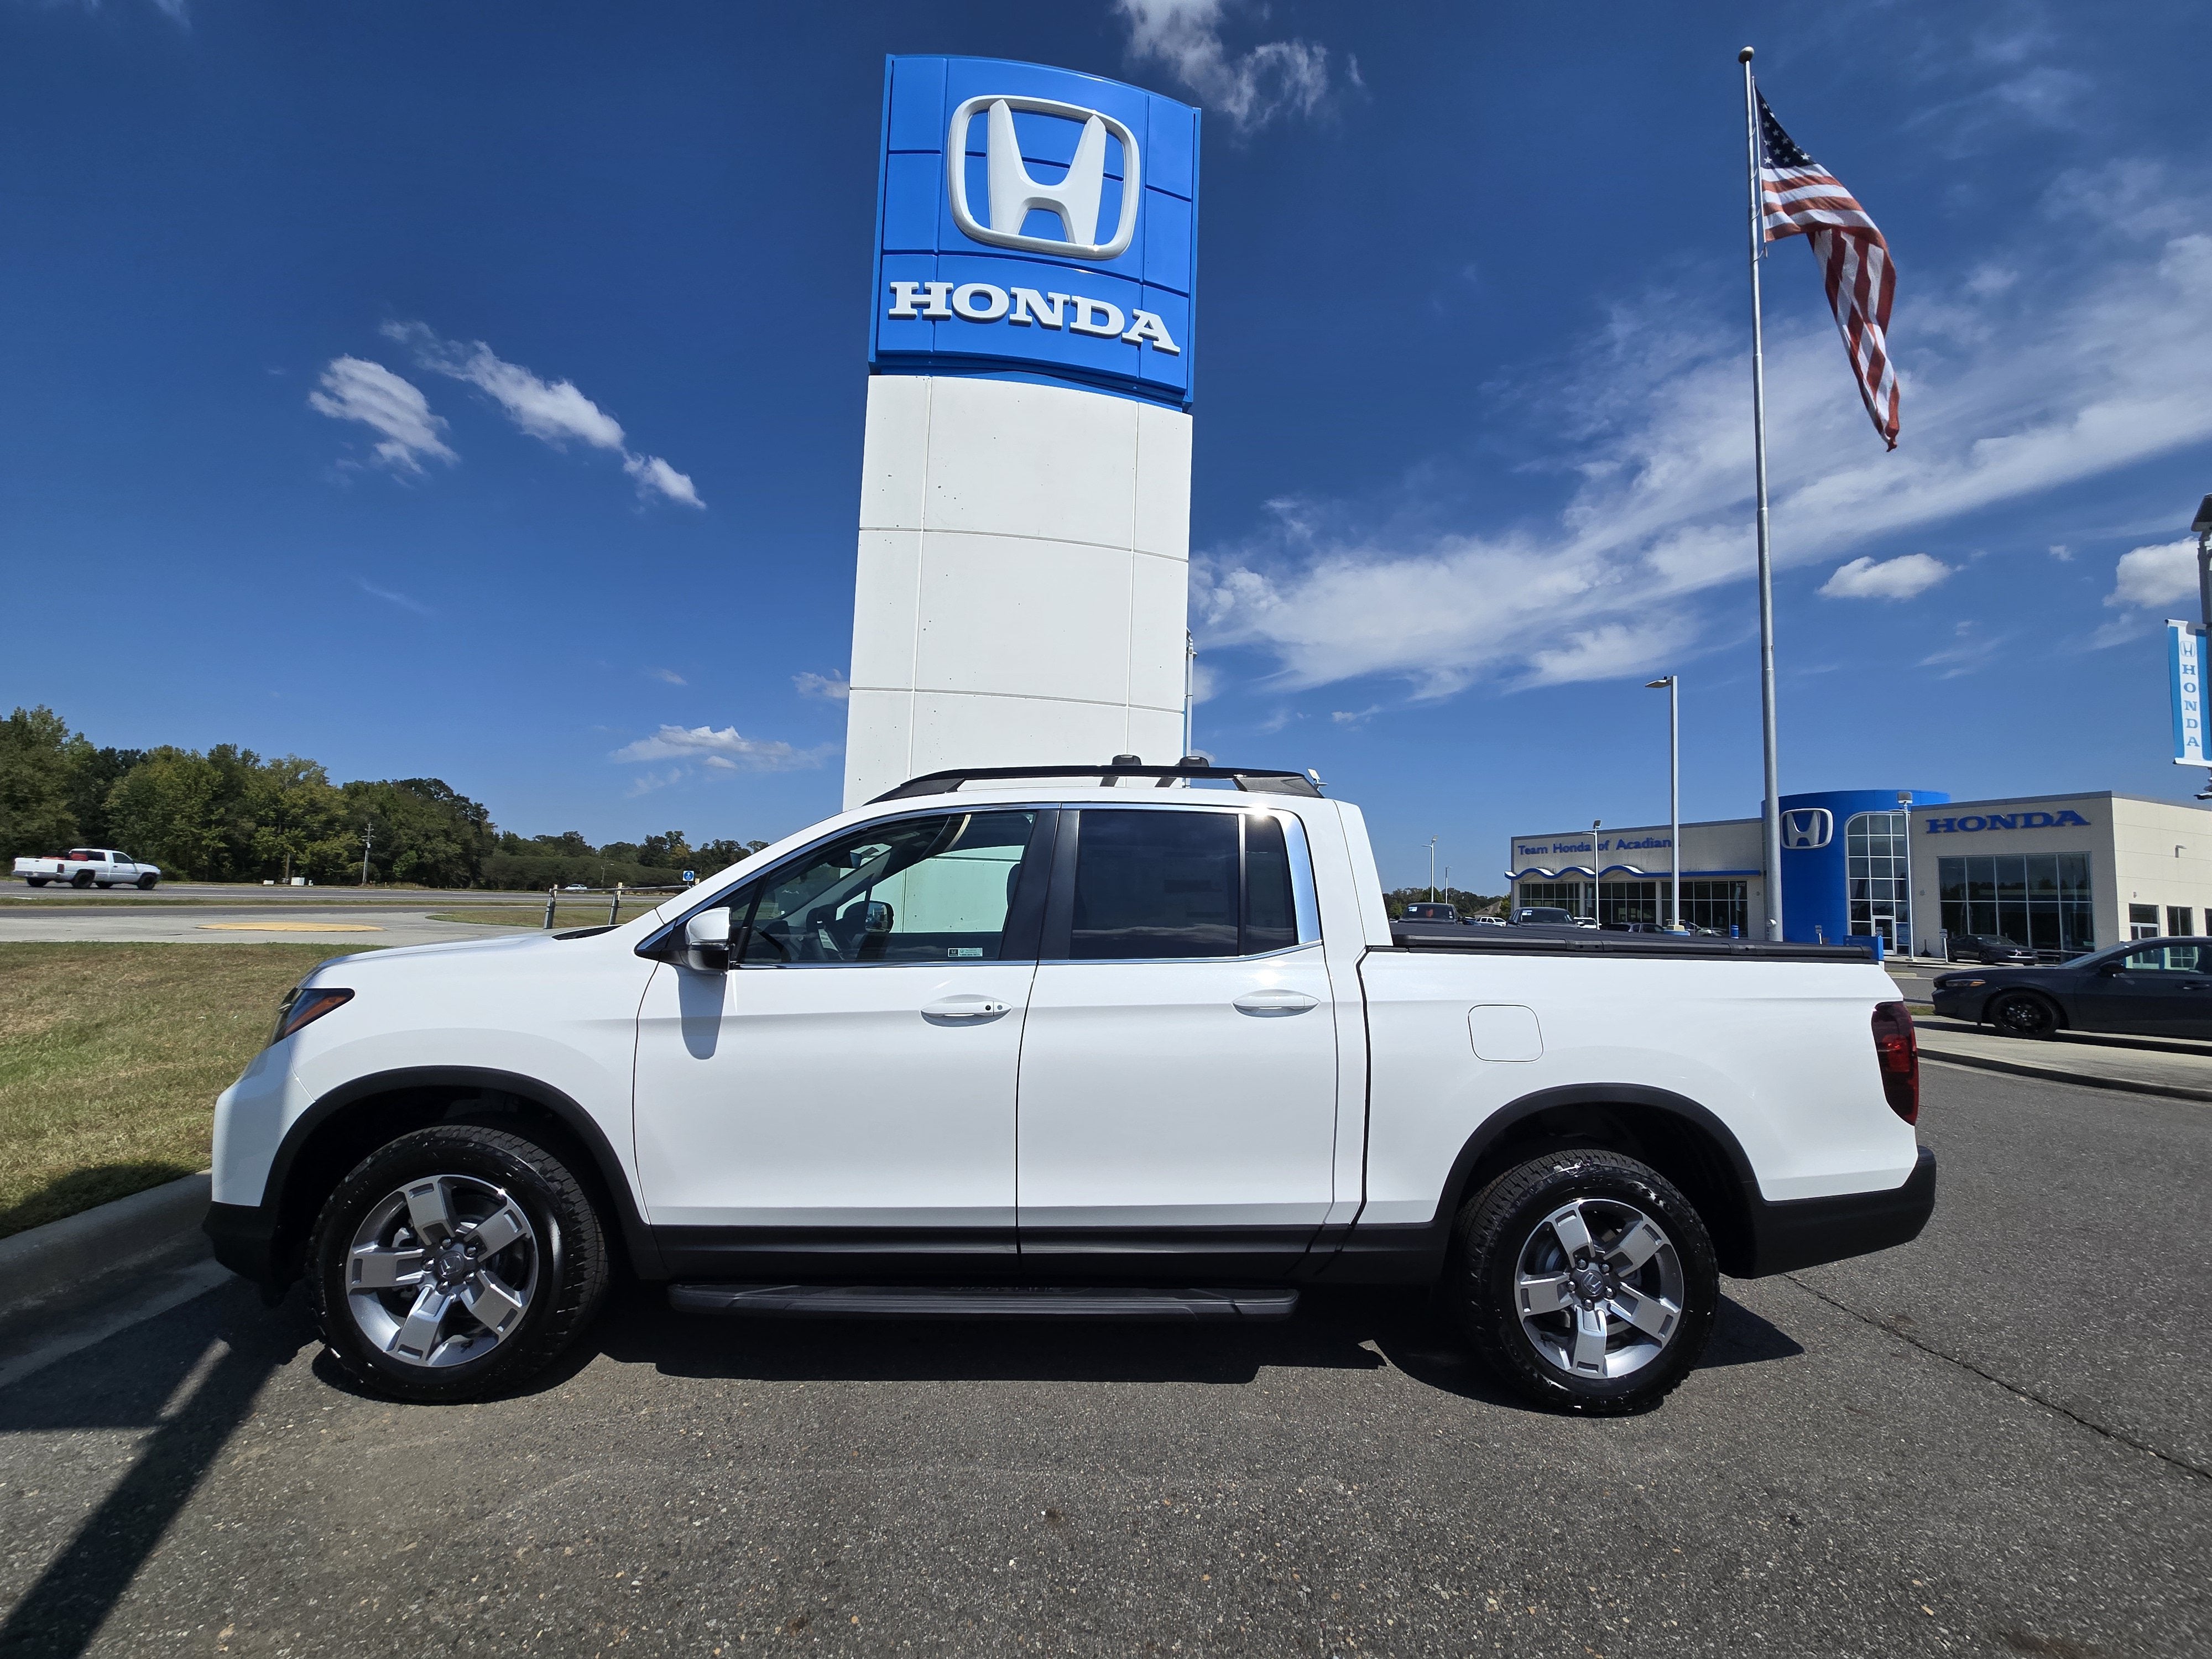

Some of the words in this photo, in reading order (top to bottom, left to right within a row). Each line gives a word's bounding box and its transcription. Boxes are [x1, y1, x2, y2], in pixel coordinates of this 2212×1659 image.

[888, 281, 1181, 355] HONDA
[2182, 664, 2200, 747] HONDA
[1517, 844, 1548, 855] Team
[1553, 841, 1592, 853] Honda
[1598, 839, 1610, 851] of
[1616, 837, 1679, 850] Acadian
[1926, 810, 2091, 834] HONDA
